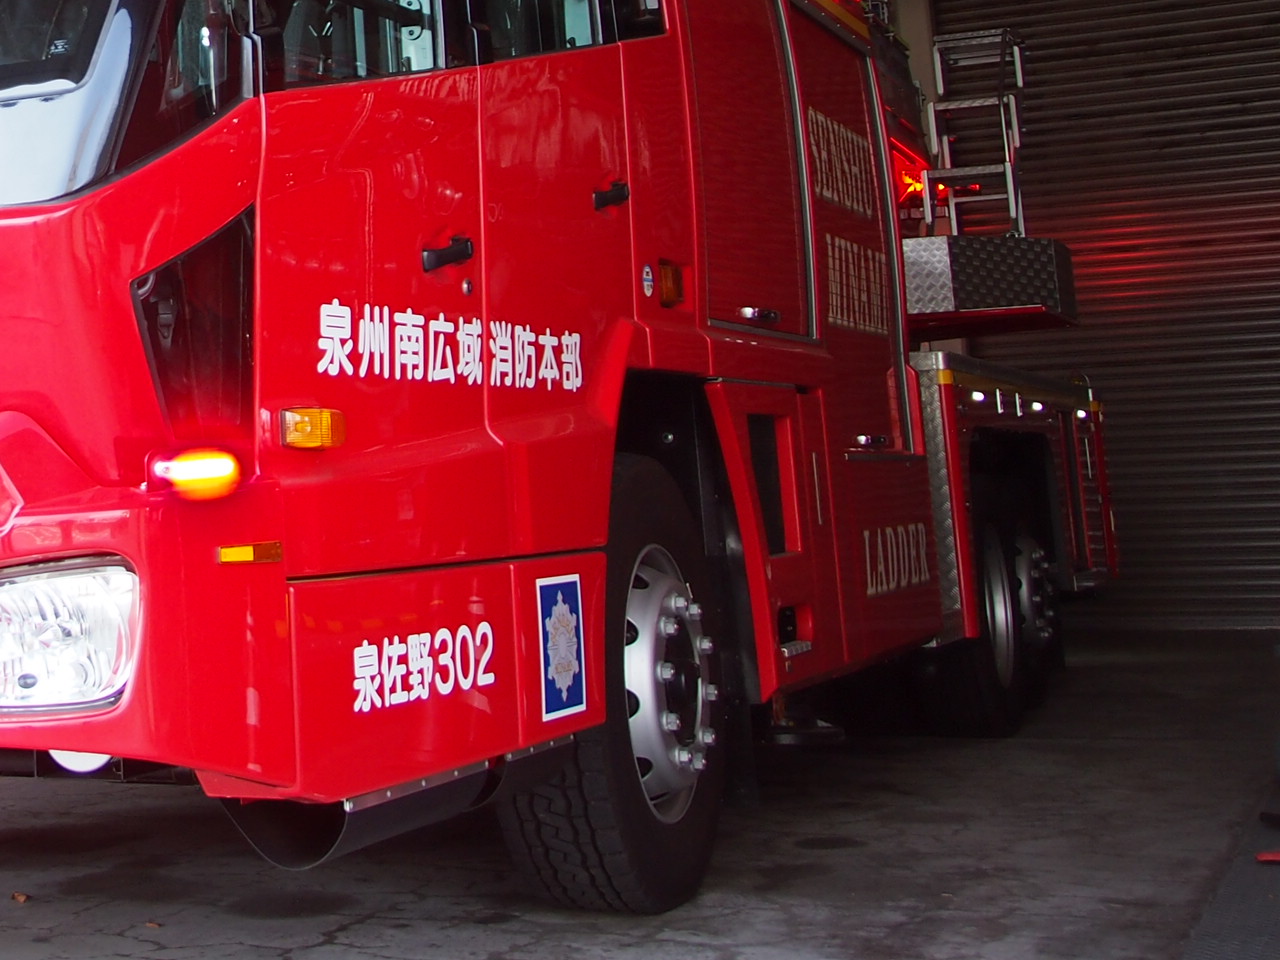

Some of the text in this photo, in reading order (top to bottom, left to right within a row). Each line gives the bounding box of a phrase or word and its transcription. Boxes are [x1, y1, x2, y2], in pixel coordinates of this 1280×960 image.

[808, 106, 873, 219] SENSHU
[826, 233, 889, 335] MINAMI
[317, 298, 583, 392] 泉州南広域消防本部
[863, 522, 931, 596] LADDER
[353, 621, 496, 713] 泉佐野302
